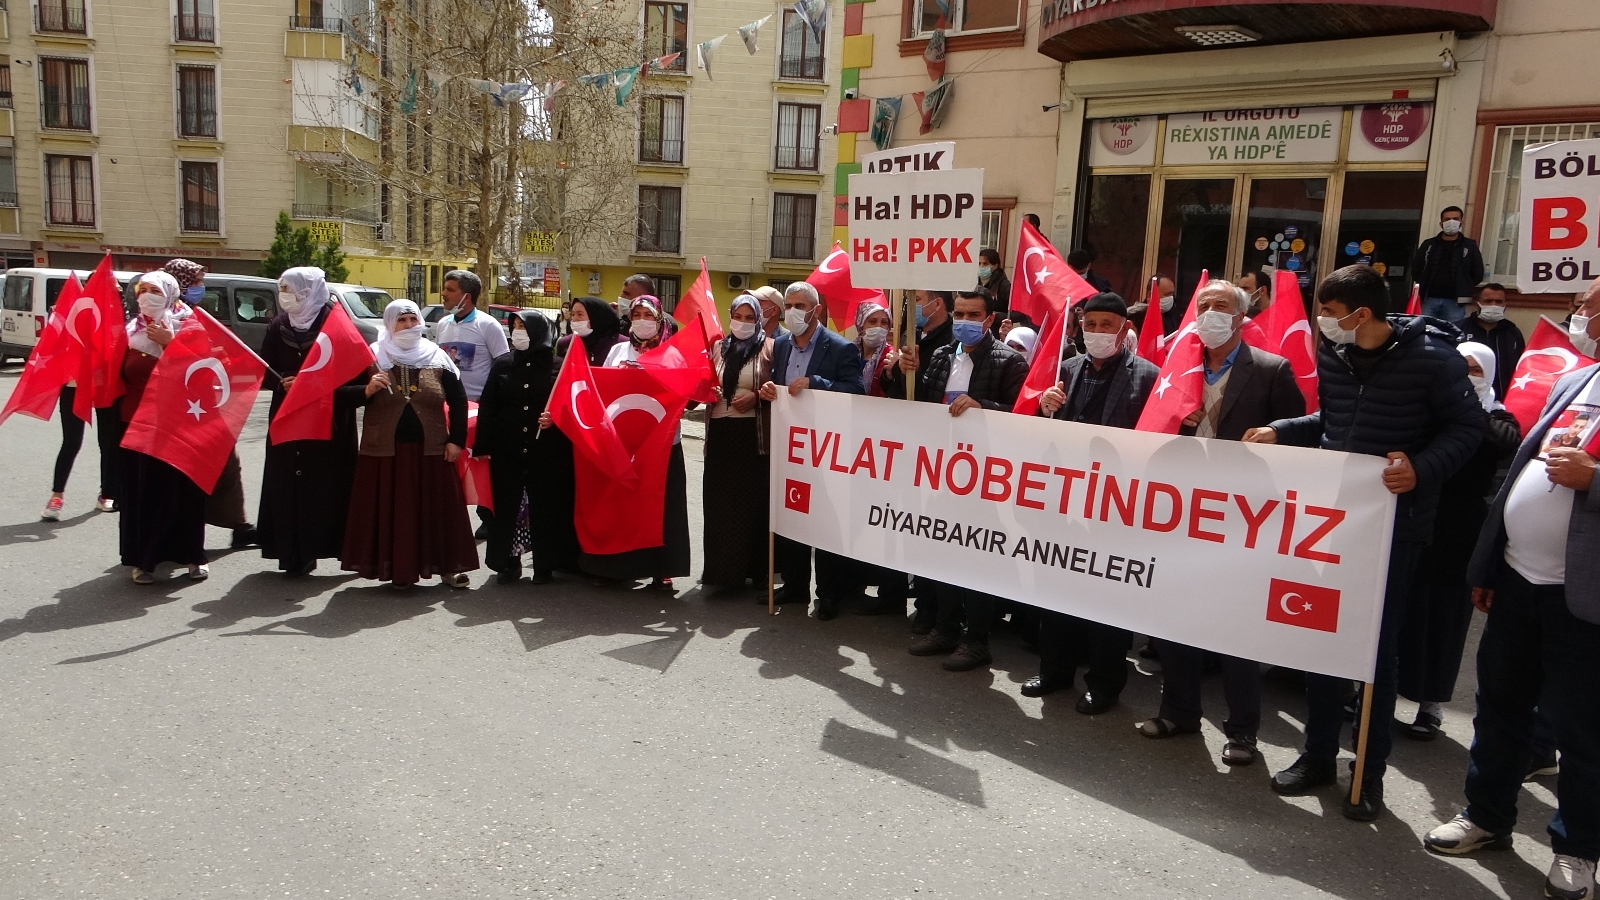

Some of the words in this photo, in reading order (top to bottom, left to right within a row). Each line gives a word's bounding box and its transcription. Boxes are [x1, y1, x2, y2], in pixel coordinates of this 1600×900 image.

[1170, 125, 1261, 143] RÊXISTINA
[1266, 120, 1332, 141] AMEDÊ
[1382, 124, 1404, 134] HDP
[1113, 139, 1133, 149] HDP
[1207, 146, 1228, 160] YA
[1234, 141, 1286, 160] HDP'Ê
[854, 195, 900, 221] Ha!
[910, 193, 975, 220] HDP
[853, 238, 898, 263] Ha!
[908, 238, 973, 263] PKK
[788, 425, 904, 481] EVLAT
[913, 442, 1346, 565] NÖBETİNDEYİZ
[867, 502, 1007, 556] DİYARBAKIR
[1011, 536, 1157, 589] ANNELERİ
